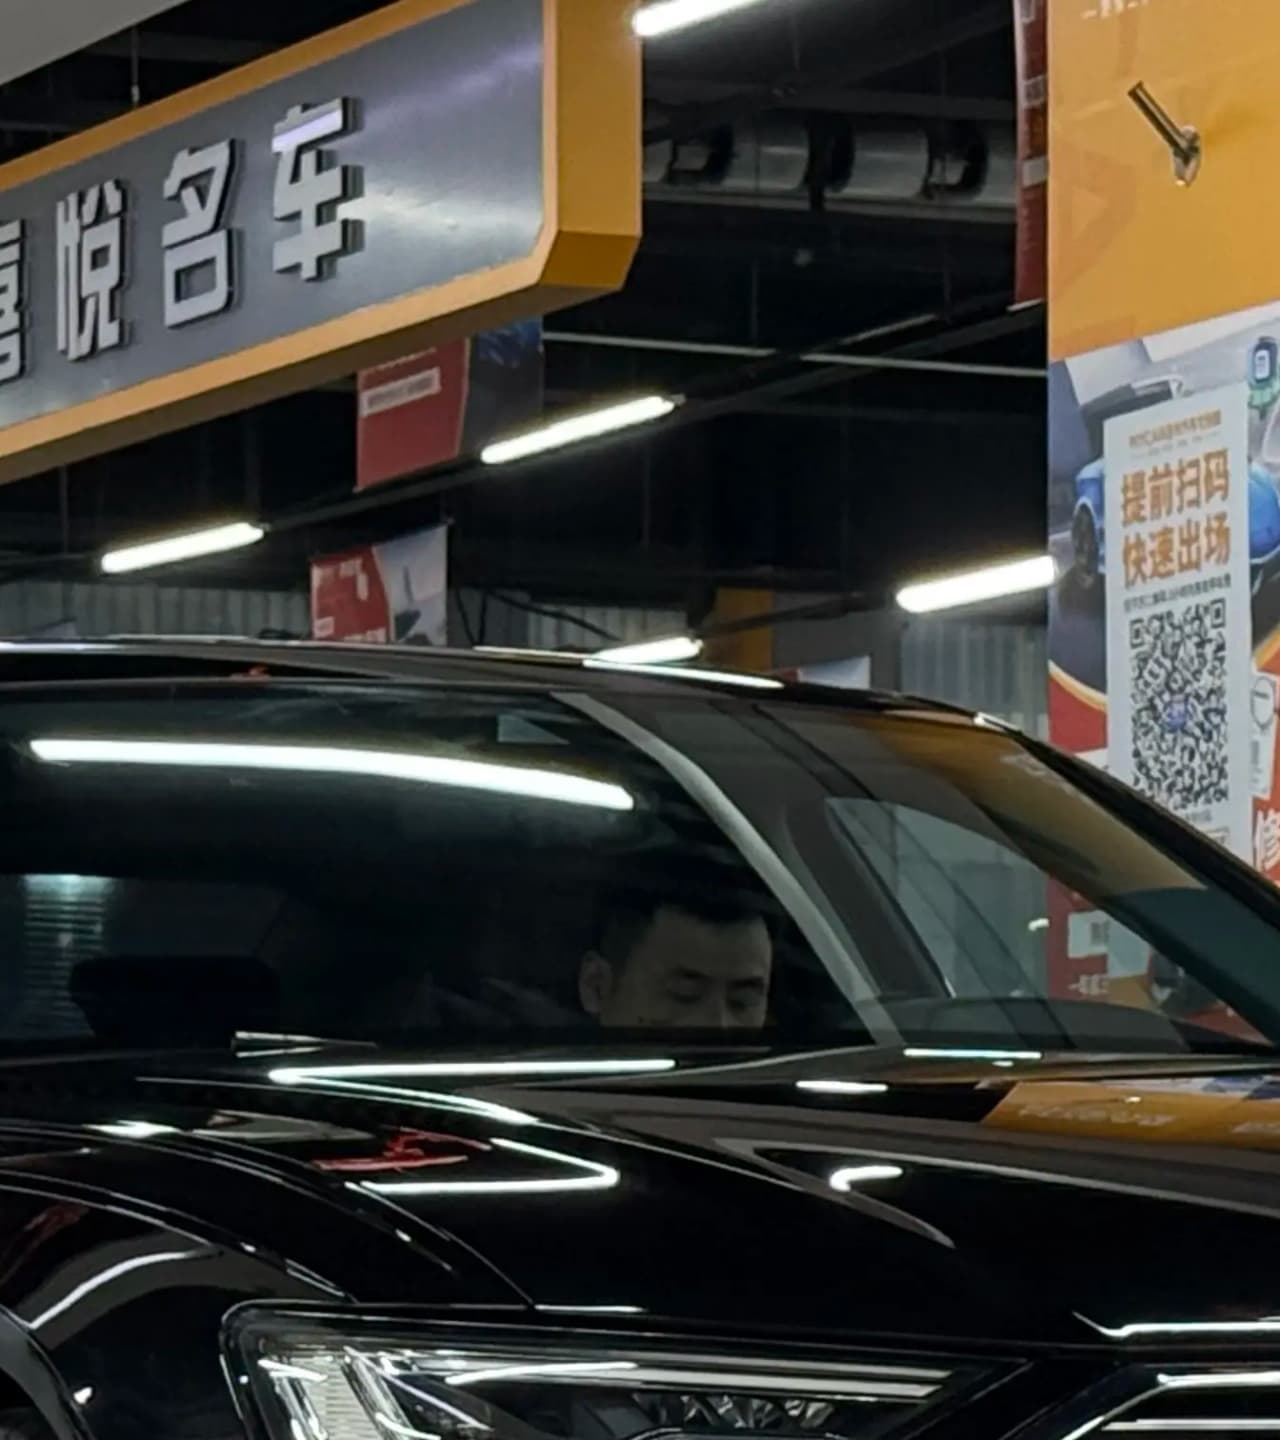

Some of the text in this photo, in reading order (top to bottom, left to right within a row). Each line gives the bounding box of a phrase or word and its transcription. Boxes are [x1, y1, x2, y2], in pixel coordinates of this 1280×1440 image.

[1122, 448, 1230, 528] 提前扫码
[1122, 512, 1231, 590] 快速出场
